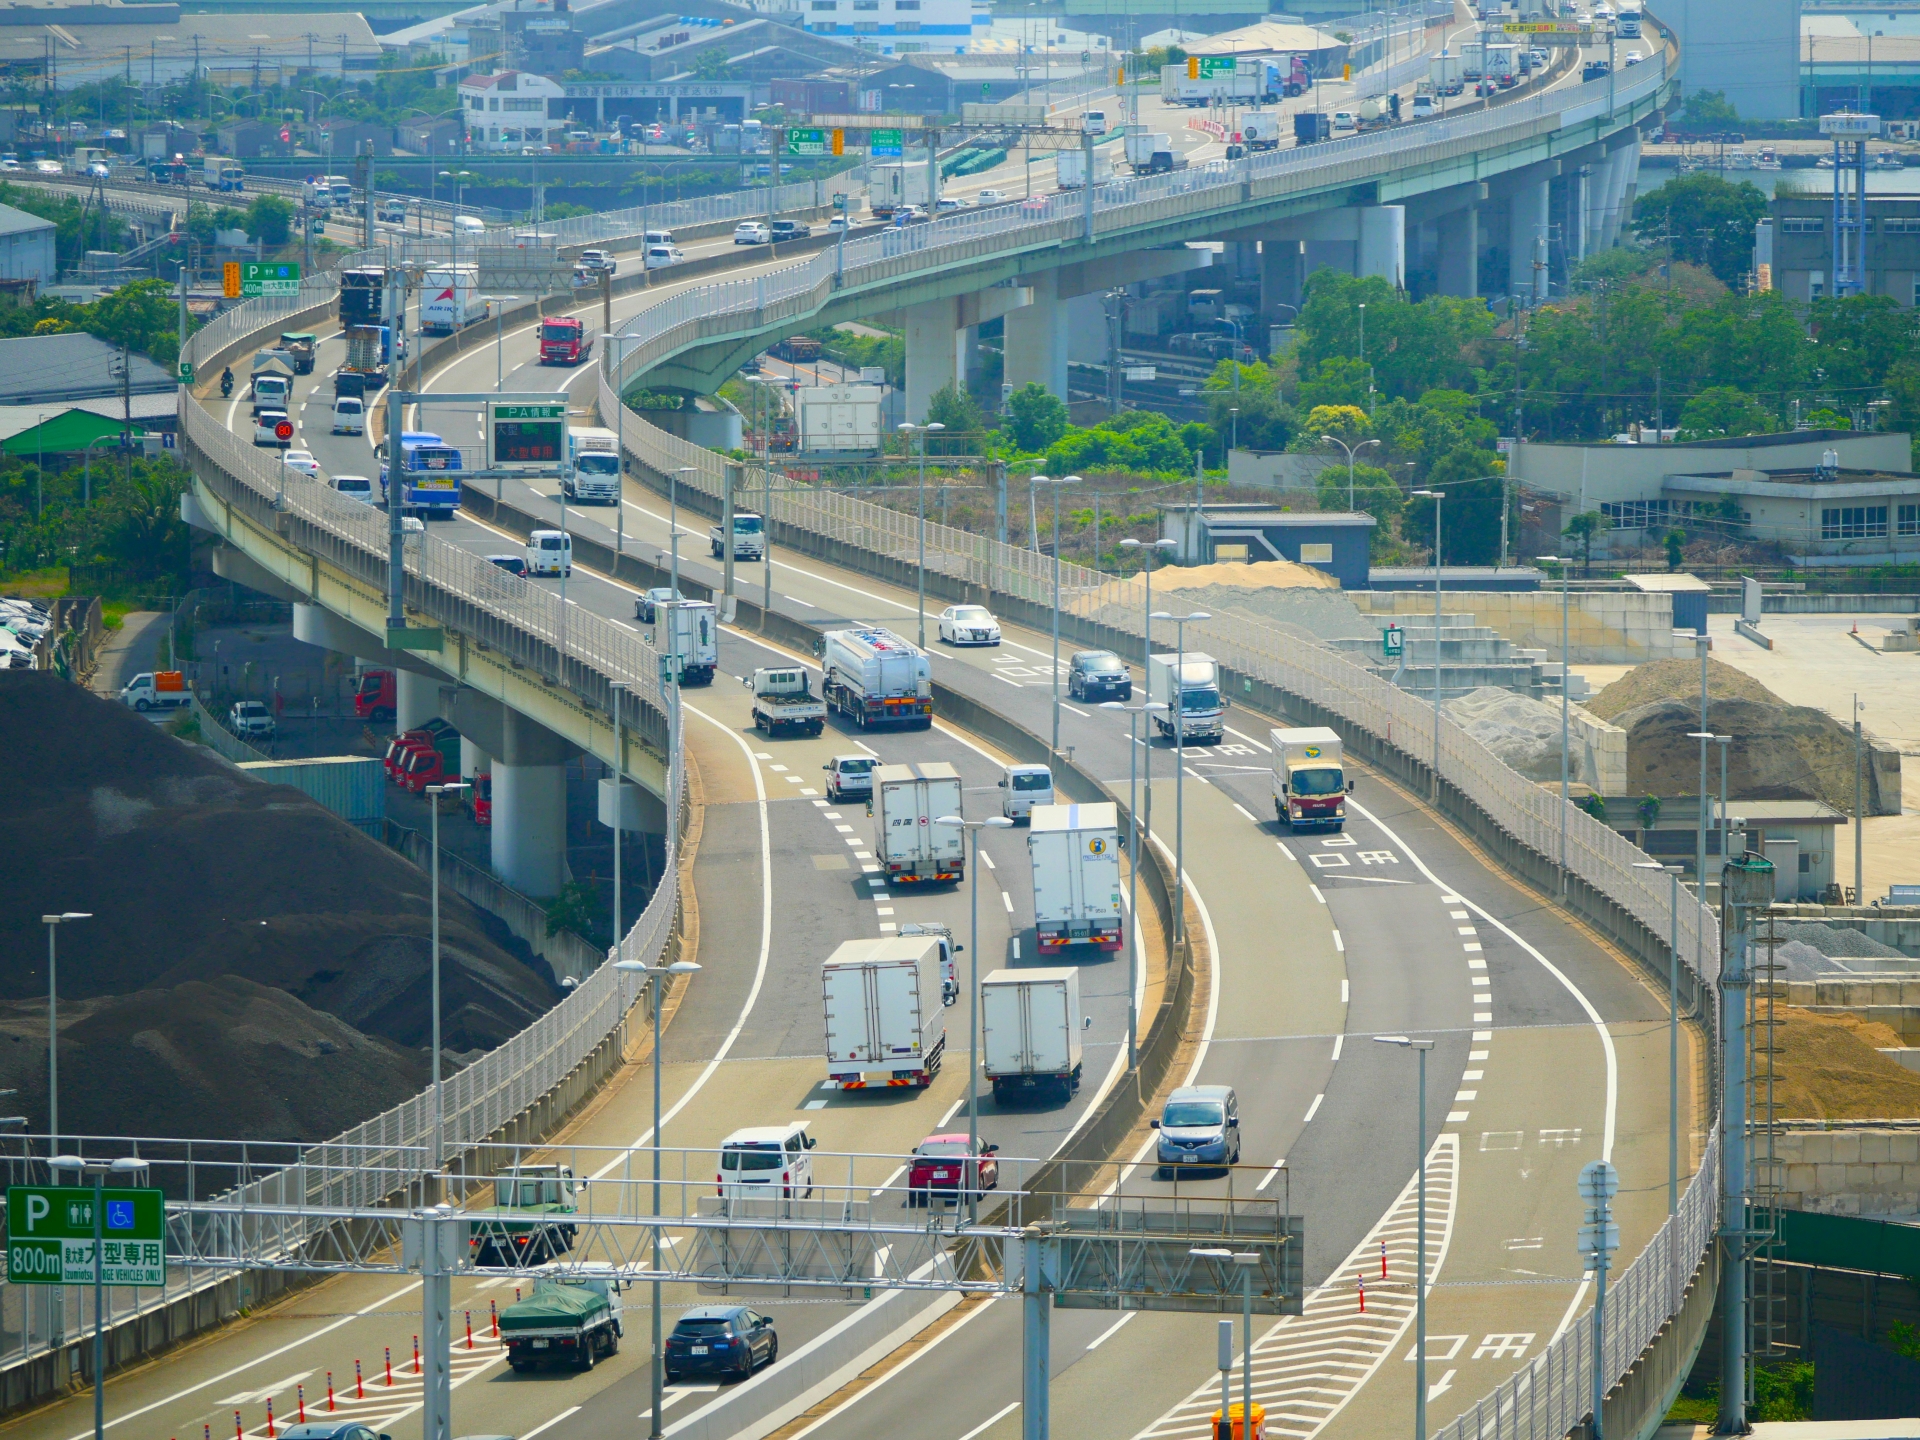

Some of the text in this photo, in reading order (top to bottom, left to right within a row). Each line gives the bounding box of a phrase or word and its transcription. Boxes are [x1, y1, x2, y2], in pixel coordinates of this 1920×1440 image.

[792, 131, 800, 141] P
[249, 265, 259, 279] P
[244, 283, 262, 294] 400m
[270, 281, 298, 290] 大型専用
[508, 407, 551, 418] PA情報
[278, 425, 291, 436] 80
[496, 424, 518, 436] 大型
[507, 446, 553, 459] 大型専用
[27, 1194, 50, 1232] P
[12, 1246, 60, 1274] 800m
[85, 1241, 160, 1266] 大型専用
[64, 1267, 94, 1281] Izumiotsu
[116, 1269, 143, 1282] VEHICLES
[145, 1269, 161, 1282] ONLY
